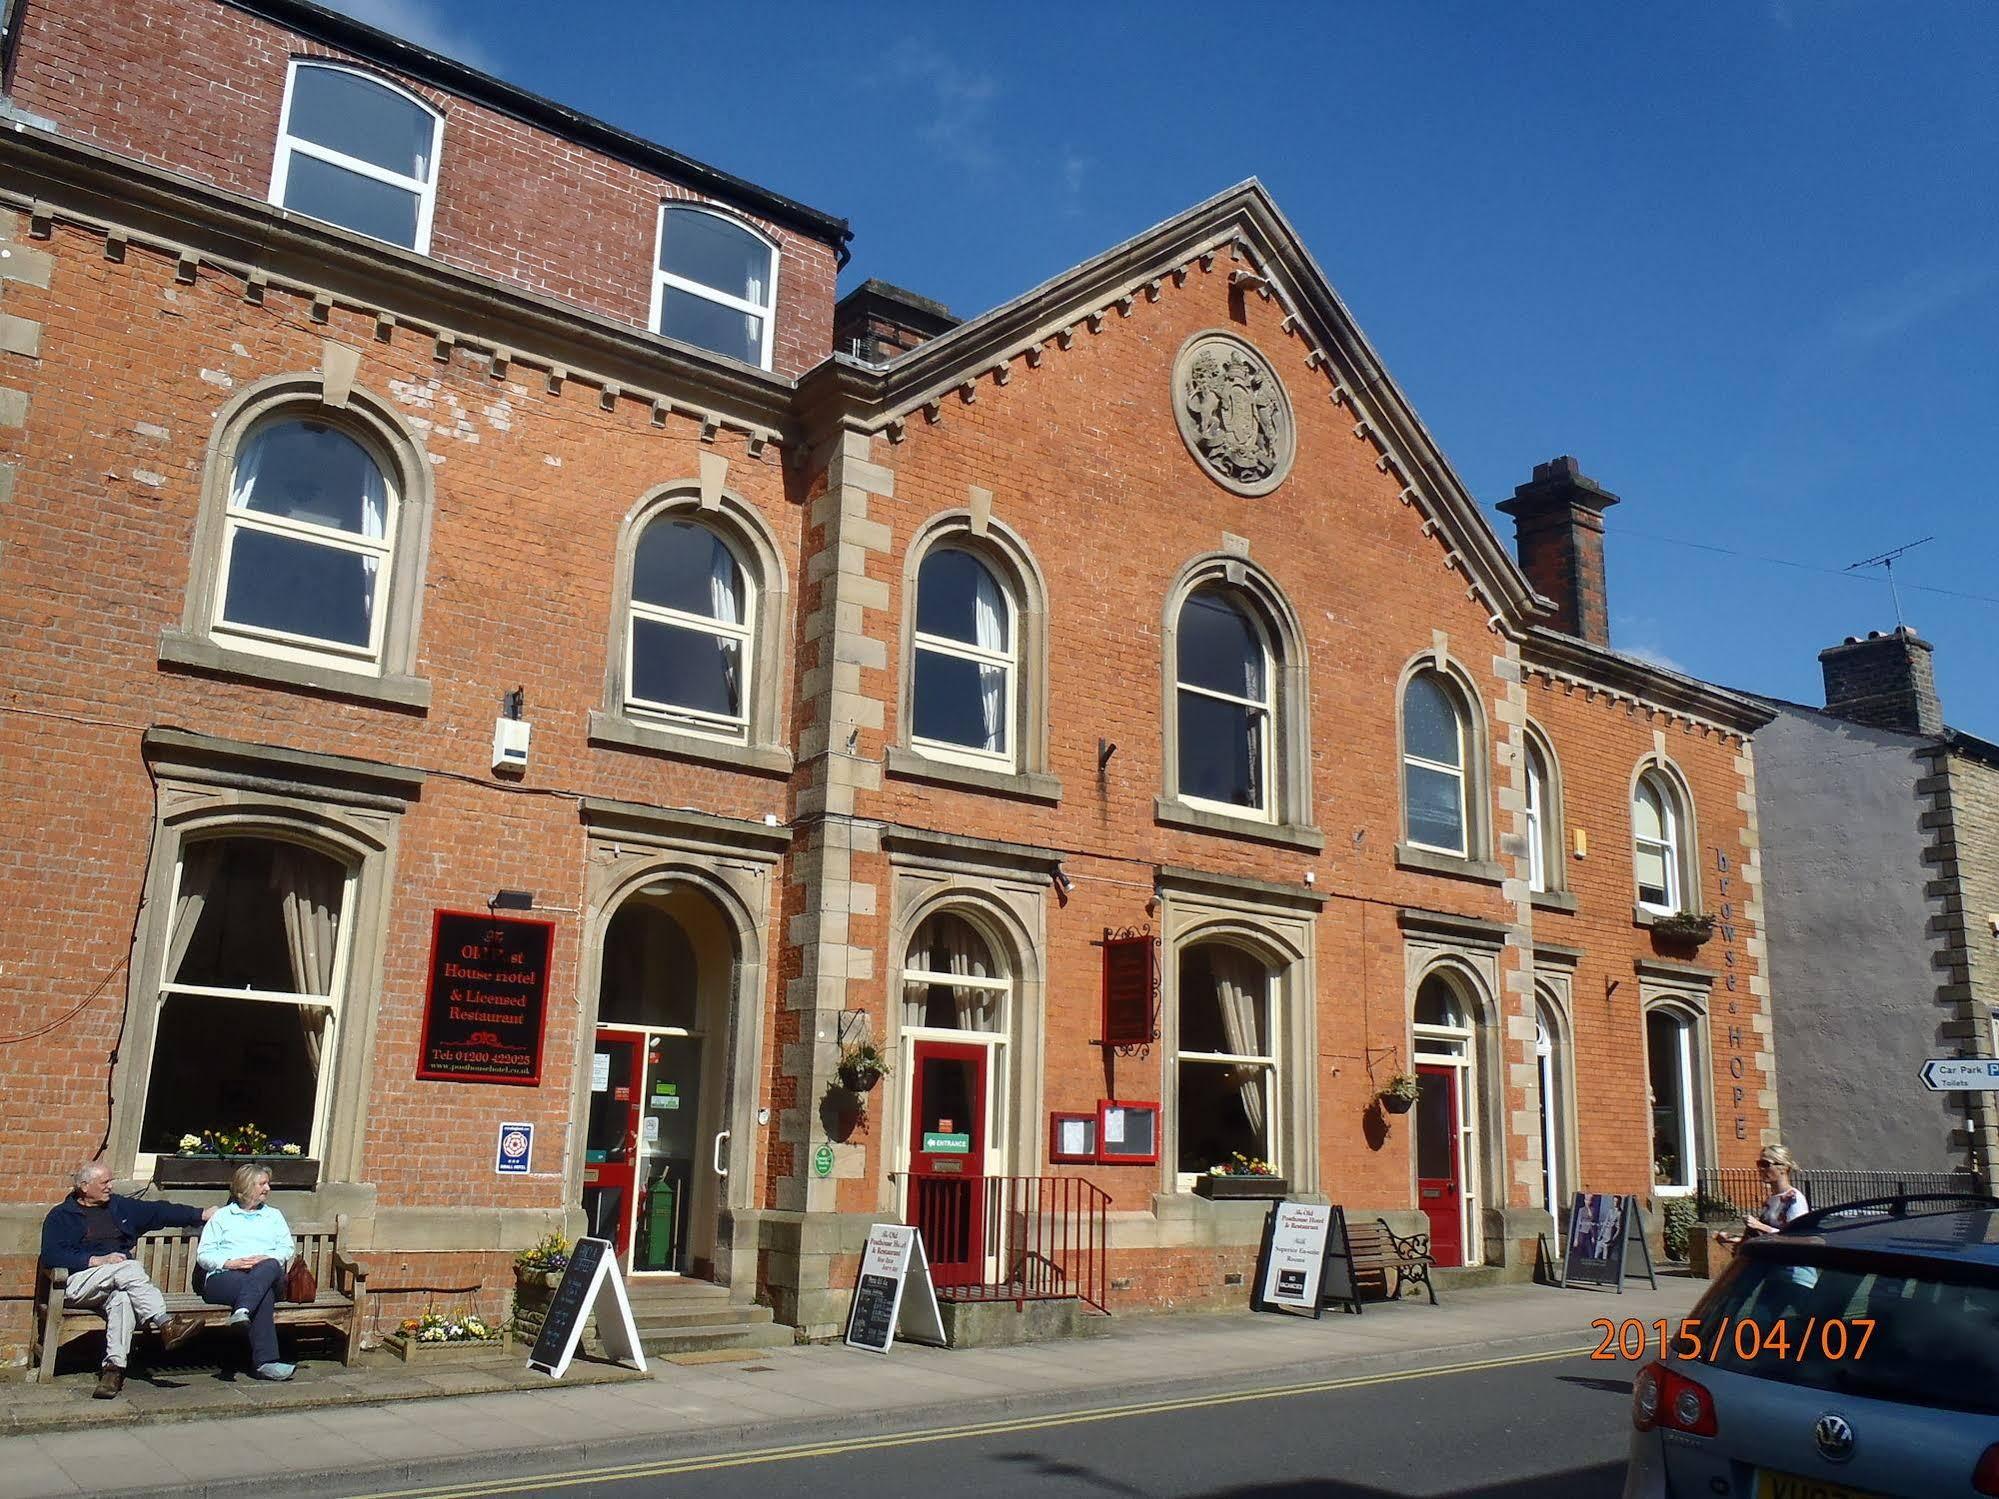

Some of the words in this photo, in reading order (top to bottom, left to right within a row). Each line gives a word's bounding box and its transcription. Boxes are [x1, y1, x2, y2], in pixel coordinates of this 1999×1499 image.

[444, 962, 492, 981] House
[450, 988, 463, 1001] &
[466, 990, 527, 1007] Licensed
[1716, 848, 1737, 990] browse
[1728, 1025, 1746, 1139] HOPE
[449, 1006, 525, 1024] Restaurant
[432, 1049, 453, 1061] Tel:
[455, 1051, 489, 1062] 01200
[491, 1053, 530, 1065] 422025
[1940, 1066, 1957, 1074] Car
[1960, 1066, 1983, 1074] Park
